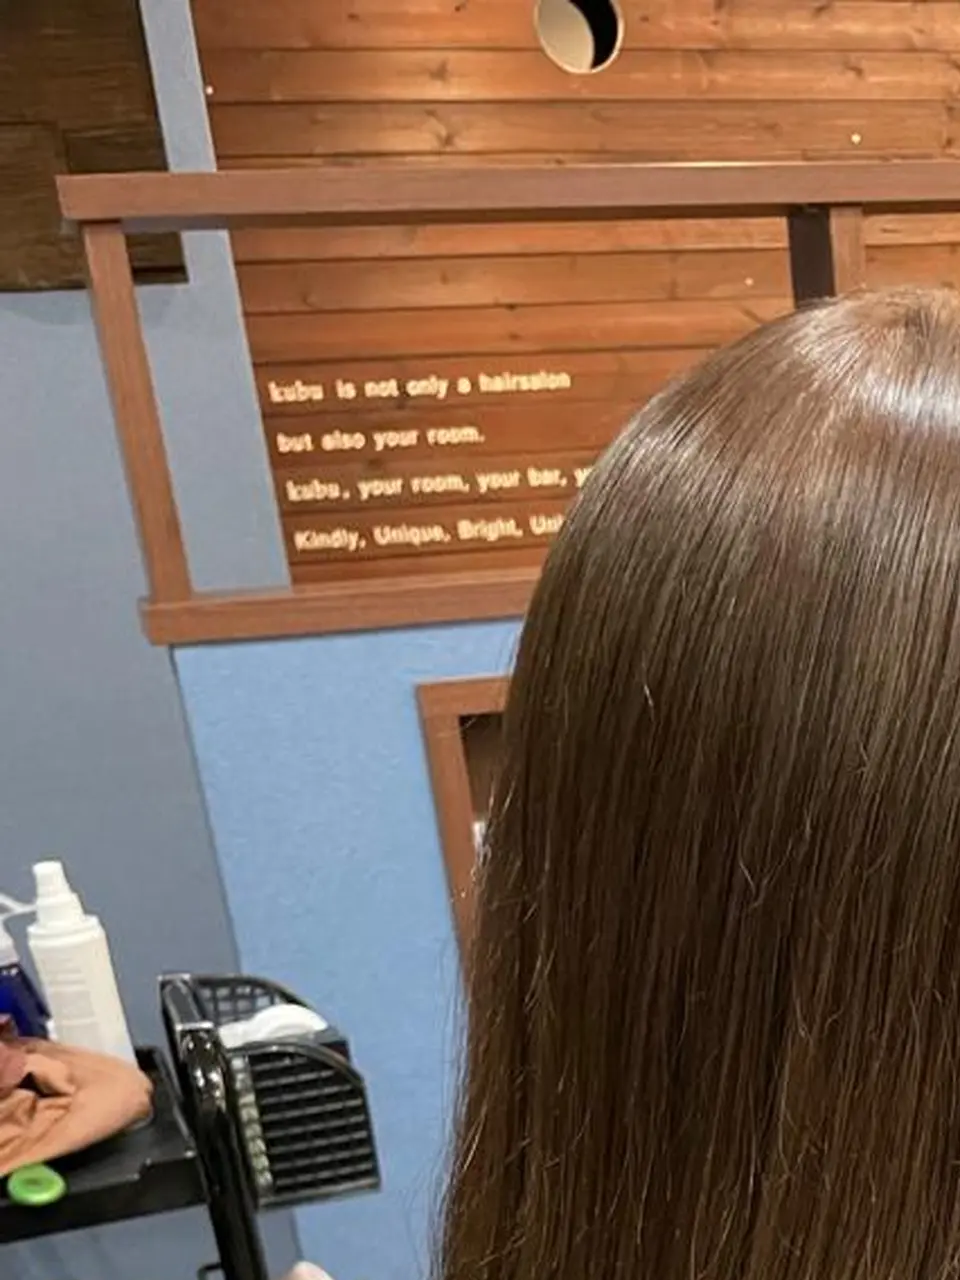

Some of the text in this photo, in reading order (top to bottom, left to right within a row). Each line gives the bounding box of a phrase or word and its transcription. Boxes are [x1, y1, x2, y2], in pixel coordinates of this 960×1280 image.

[335, 378, 357, 400] is
[364, 378, 399, 398] not
[406, 374, 449, 400] only
[457, 376, 472, 395] a
[478, 370, 572, 393] hairsalon
[276, 426, 486, 453] but also your room.
[357, 477, 403, 501] your
[476, 470, 521, 494] your
[294, 527, 367, 552] Kindly,
